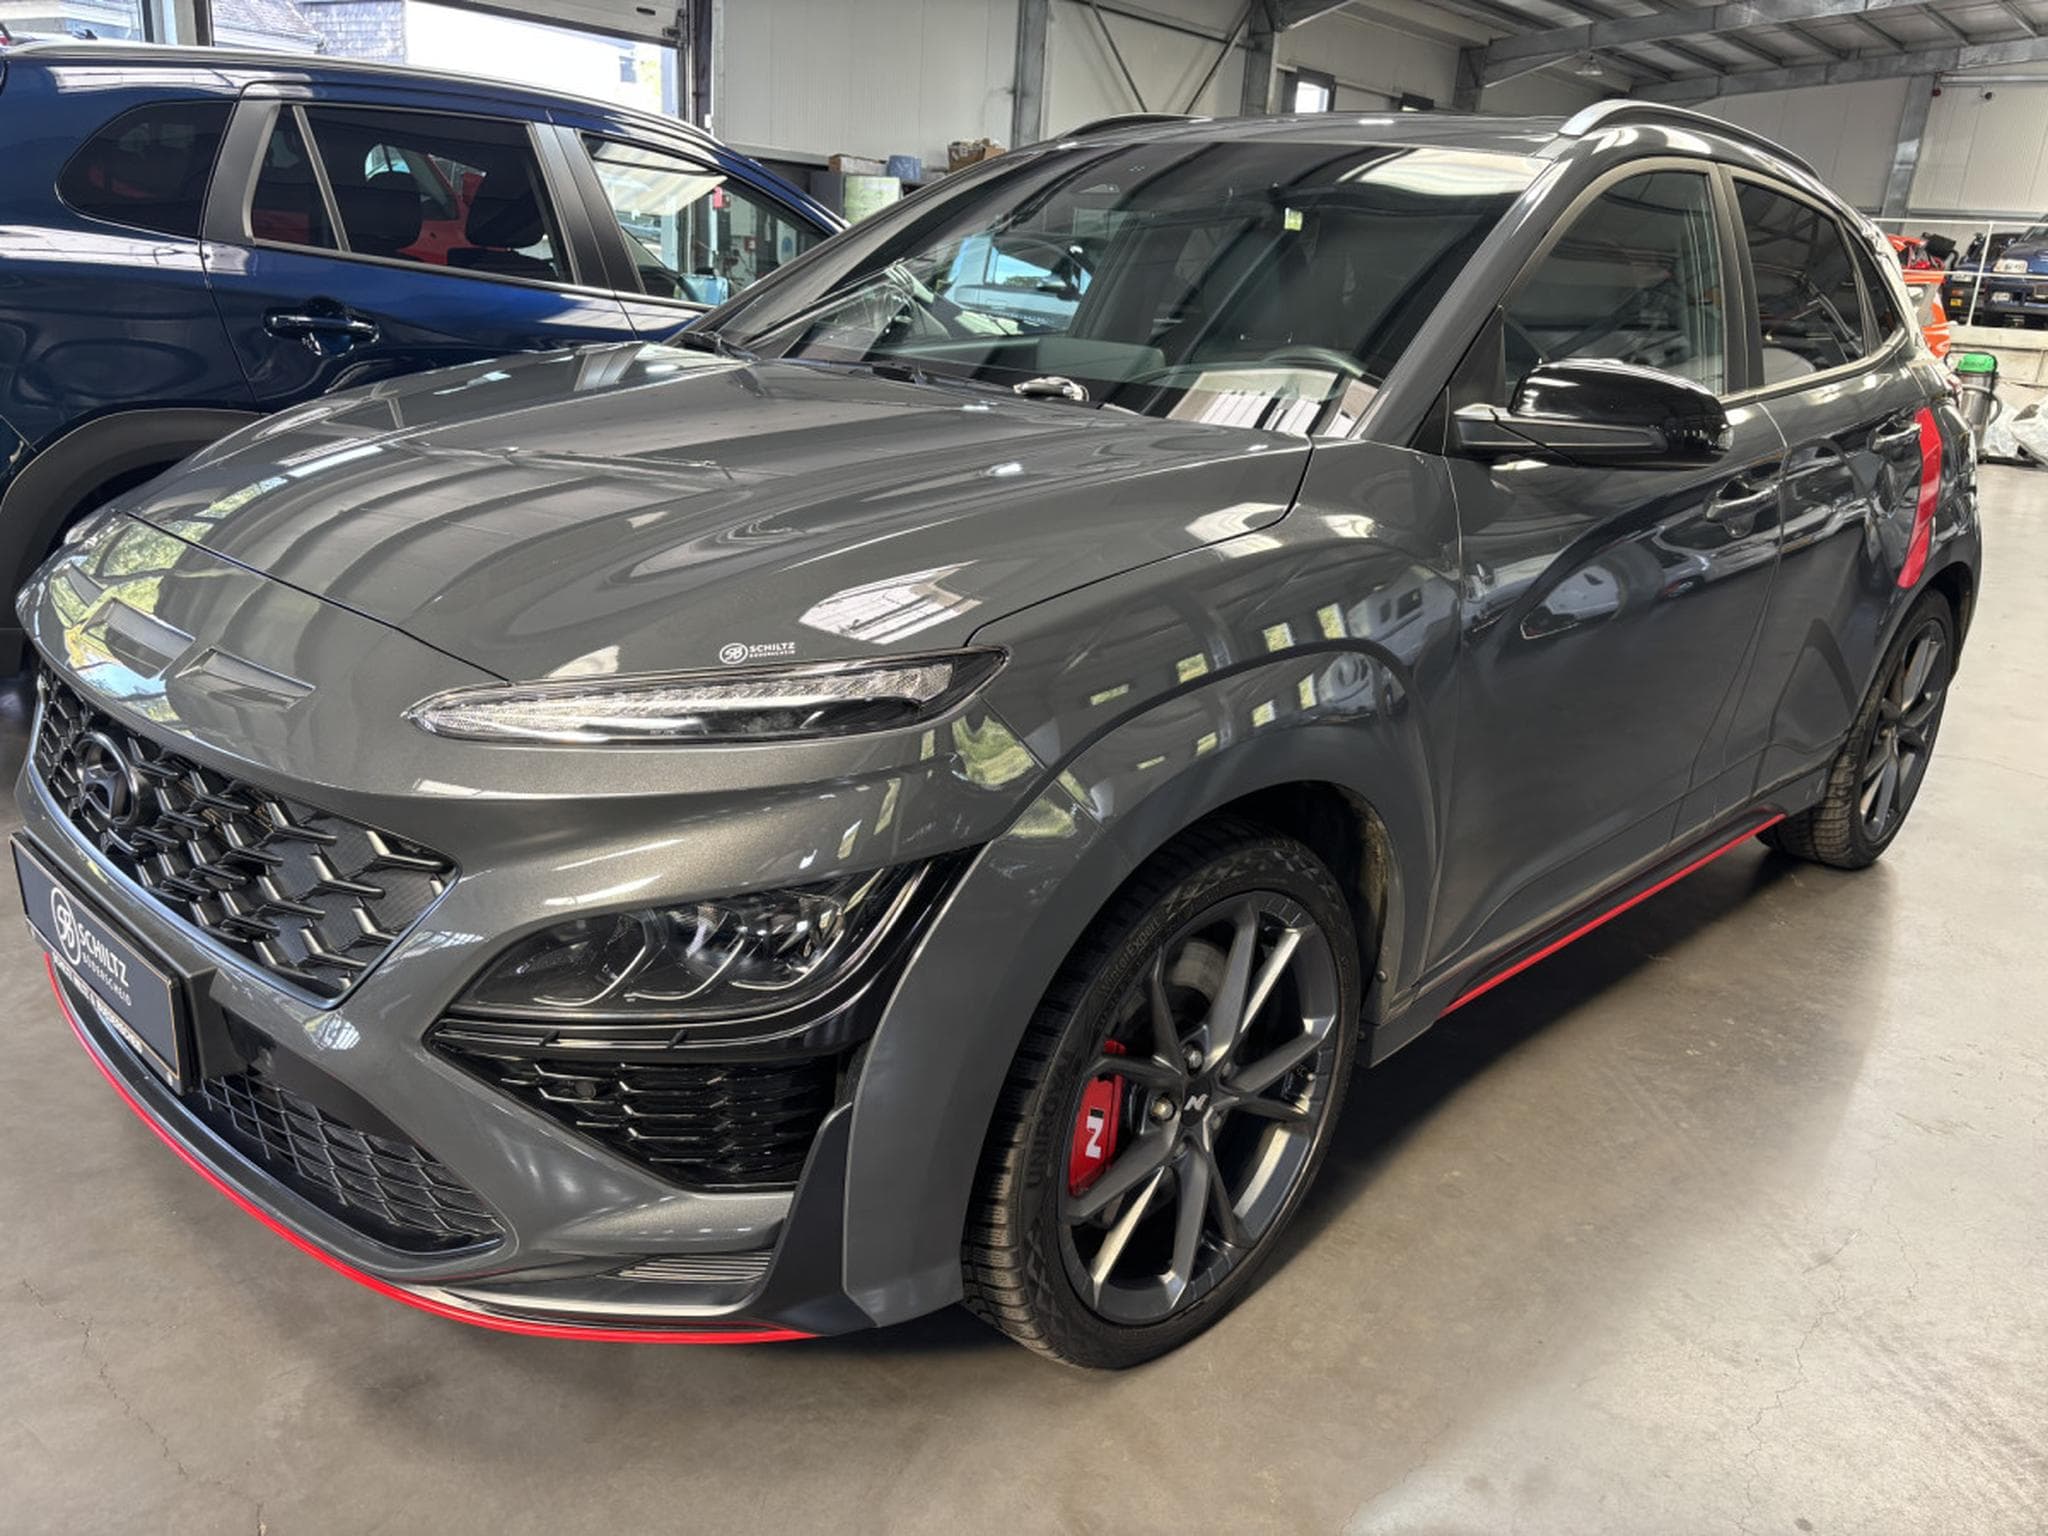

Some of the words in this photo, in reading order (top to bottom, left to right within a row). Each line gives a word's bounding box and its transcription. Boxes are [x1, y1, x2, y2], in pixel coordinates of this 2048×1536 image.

[749, 641, 796, 653] SCHILTZ
[78, 922, 130, 988] SCHILTZ
[1183, 1093, 1208, 1111] N
[1085, 1115, 1105, 1160] N
